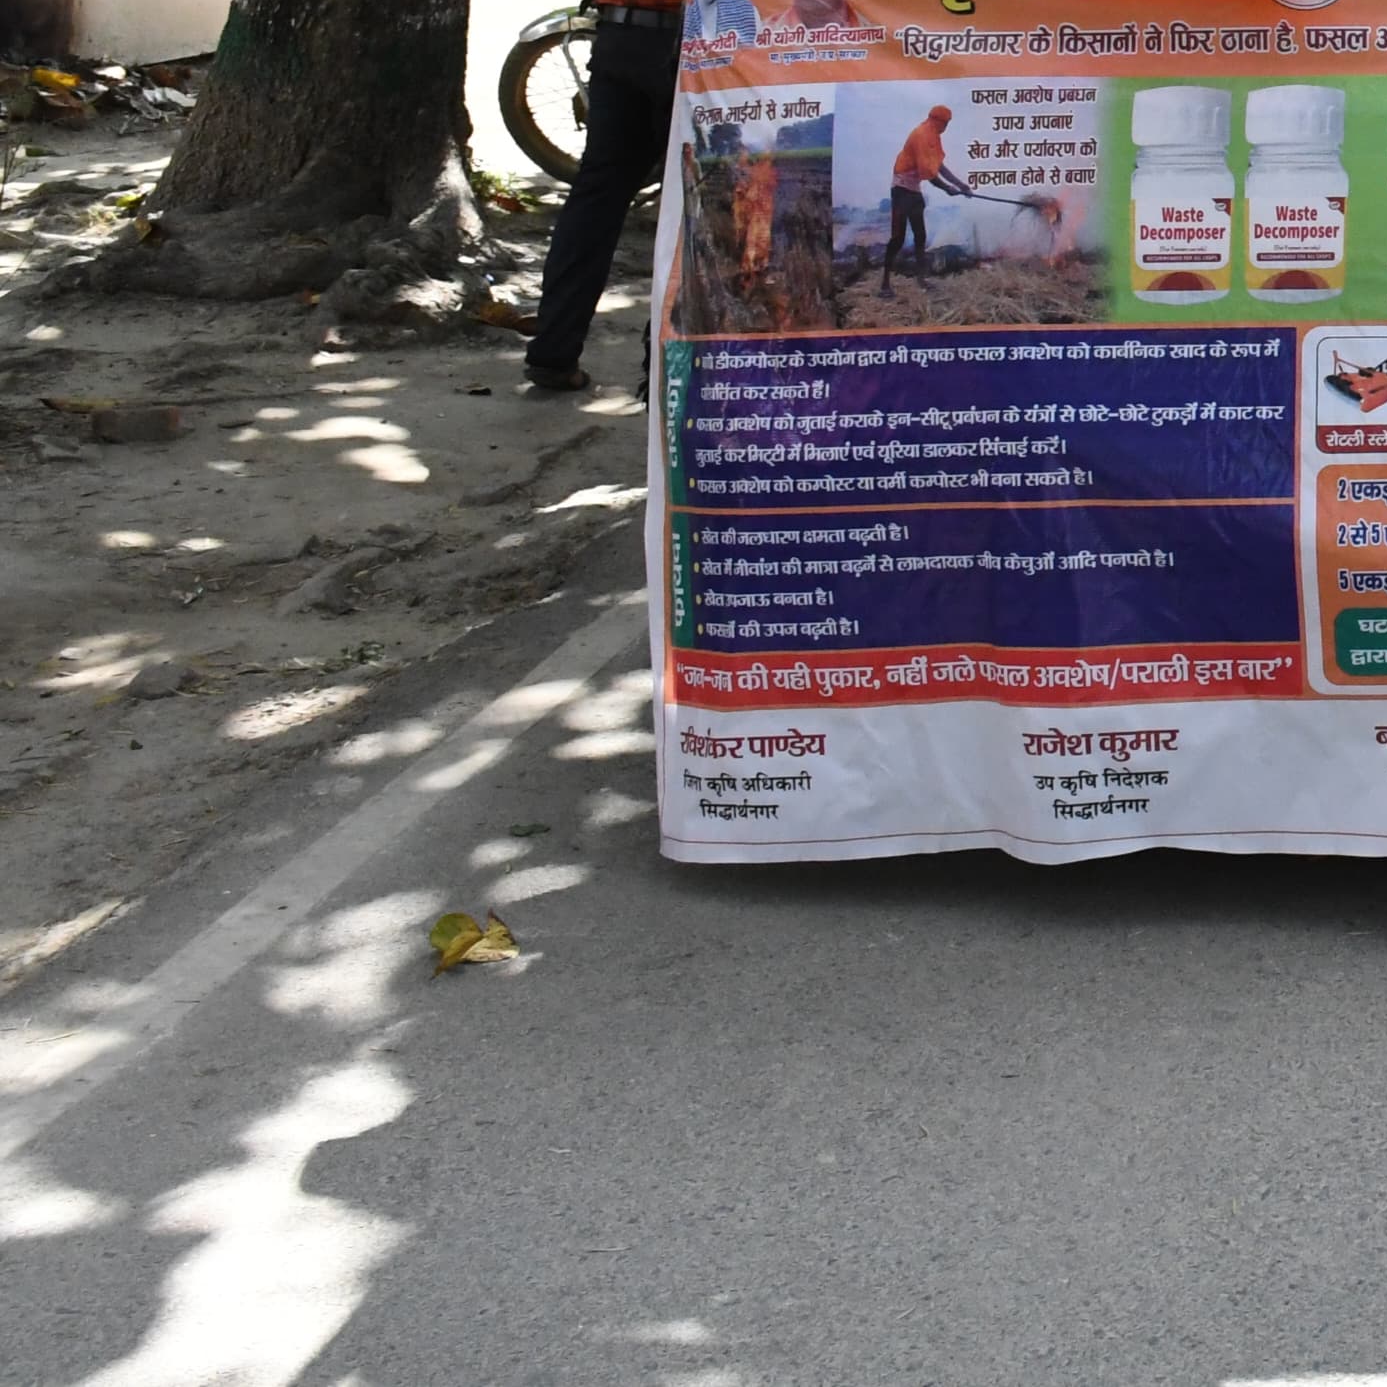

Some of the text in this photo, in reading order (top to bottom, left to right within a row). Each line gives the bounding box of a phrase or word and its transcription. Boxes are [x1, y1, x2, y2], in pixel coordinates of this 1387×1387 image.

[756, 27, 771, 46] श्री
[774, 26, 805, 45] योगी
[1029, 27, 1053, 53] के
[1058, 24, 1139, 53] किसानों
[1145, 24, 1163, 53] ने
[1170, 22, 1216, 53] फिर
[1221, 25, 1270, 52] ठाना
[1306, 25, 1368, 53] फसल
[972, 84, 1096, 105] फसल अवशेष प्रबंधन
[766, 97, 821, 121] से अपील
[992, 110, 1073, 131] उपाय अपनाएं
[968, 138, 1097, 159] खेत और पर्यावरण को
[968, 164, 1096, 190] नुकसान होने से बचाएं
[1161, 207, 1204, 223] Waste
[1275, 205, 1318, 222] Waste
[1140, 225, 1226, 243] Decomposer
[1254, 223, 1339, 242] Decomposer
[807, 339, 1281, 367] उपयोग भी कृषक फसल अवशेष को खाद के रूप में
[1338, 479, 1346, 499] 2
[1338, 525, 1346, 545] 2
[1350, 520, 1368, 544] से
[1371, 524, 1380, 543] 5
[897, 549, 1152, 572] लाभदायक आदि पनपते
[1339, 570, 1348, 590] 5
[737, 654, 1233, 696] की यही पुकार, नहीं जले अवशेष/पराली इस
[748, 728, 826, 757] पाण्डेय
[1023, 728, 1179, 762] राजेश कुमार
[705, 771, 811, 797] कृषि अधिकारी
[1034, 768, 1169, 796] उप कृषि निदेशक
[700, 799, 779, 820] सिद्धार्थनगर
[1053, 795, 1149, 820] सिद्धार्थनगर
